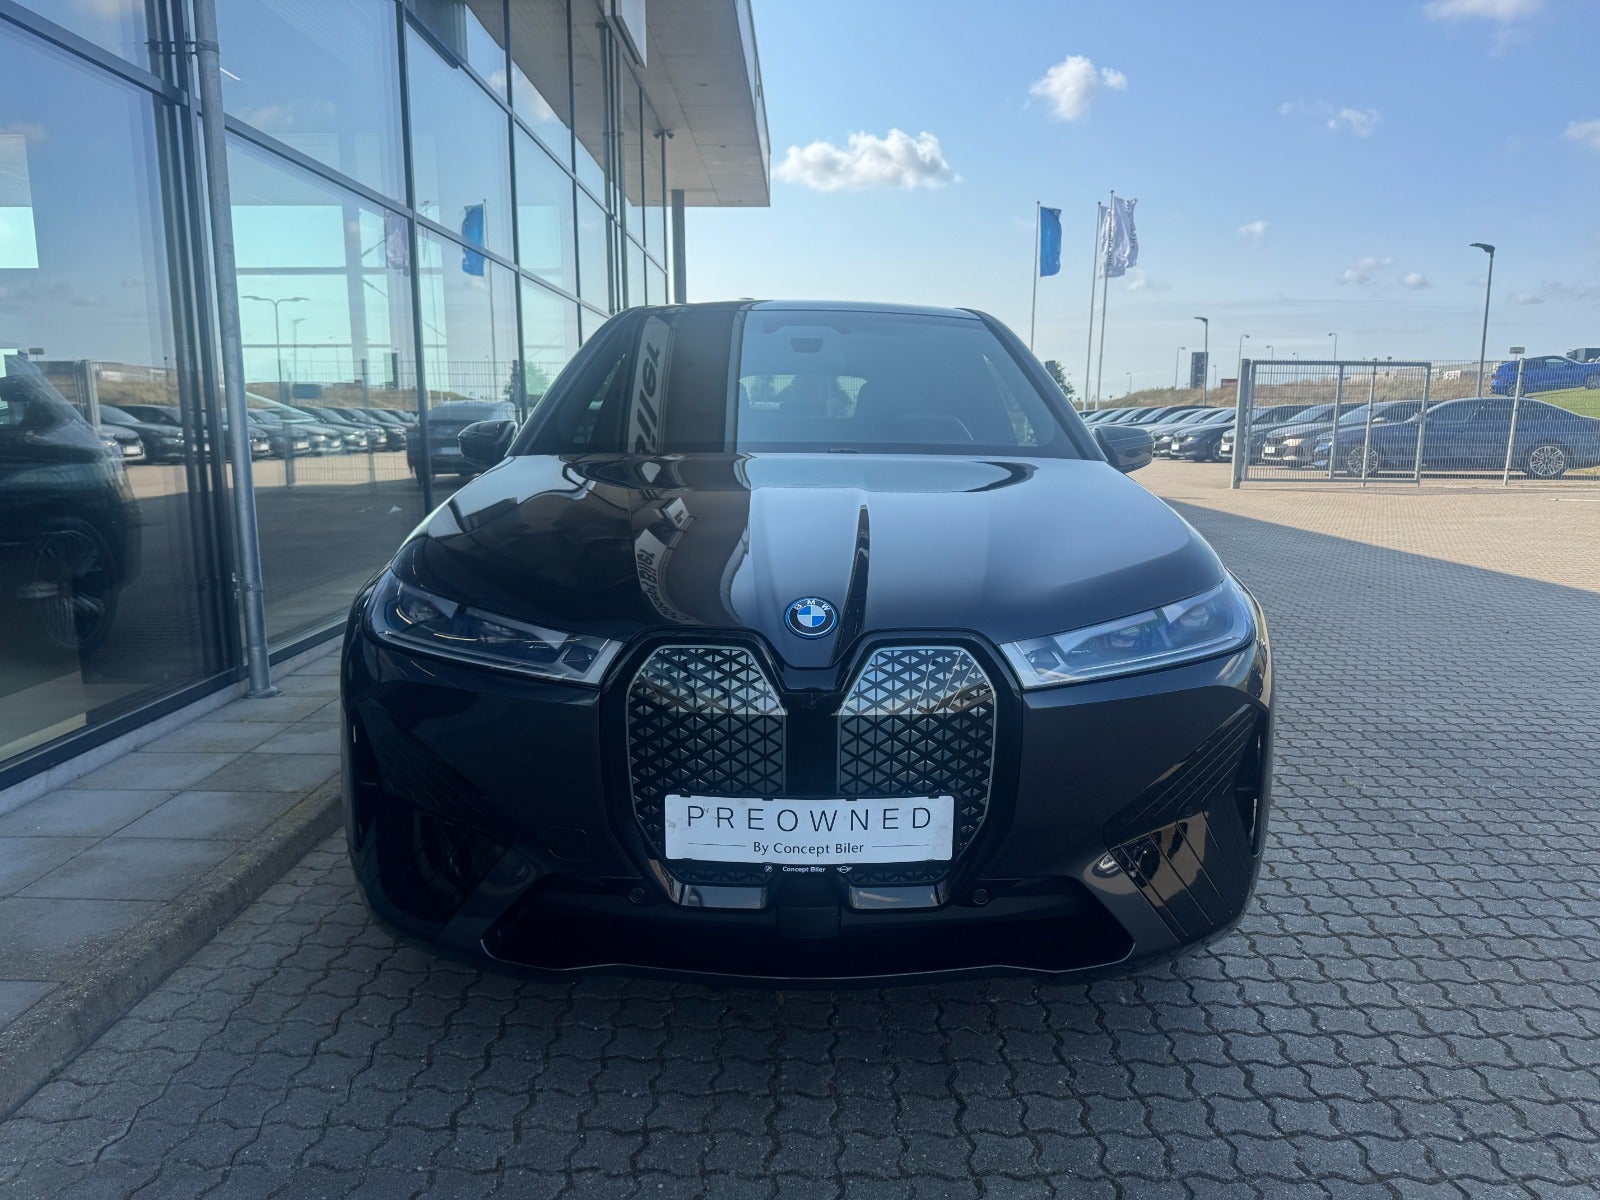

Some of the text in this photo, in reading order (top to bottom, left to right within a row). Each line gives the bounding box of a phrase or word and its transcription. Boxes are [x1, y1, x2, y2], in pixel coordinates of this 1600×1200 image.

[792, 599, 831, 611] BMW
[687, 805, 931, 832] PREOWNED
[753, 841, 865, 858] By Concept Biler
